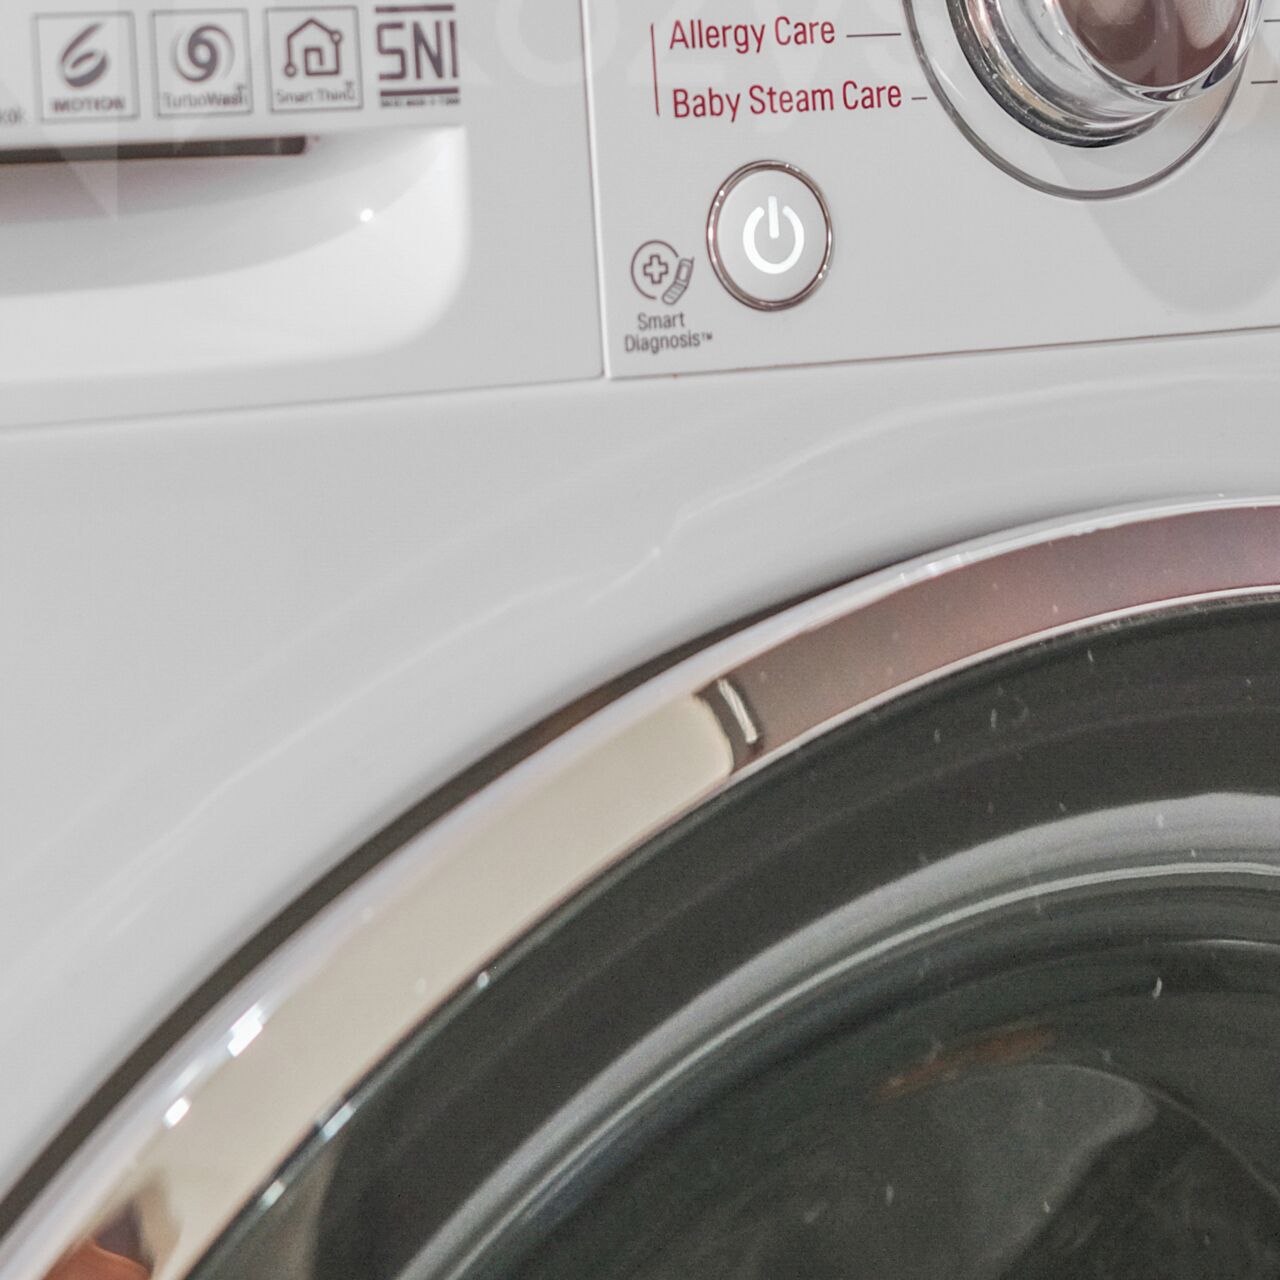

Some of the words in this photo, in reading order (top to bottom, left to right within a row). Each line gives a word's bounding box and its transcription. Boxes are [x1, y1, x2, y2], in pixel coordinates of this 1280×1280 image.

[377, 20, 460, 81] SNI
[670, 19, 766, 54] Allergy
[775, 16, 836, 46] Care
[674, 87, 741, 122] Baby
[750, 84, 834, 114] Steam
[843, 80, 903, 111] Care
[637, 314, 685, 330] Smart
